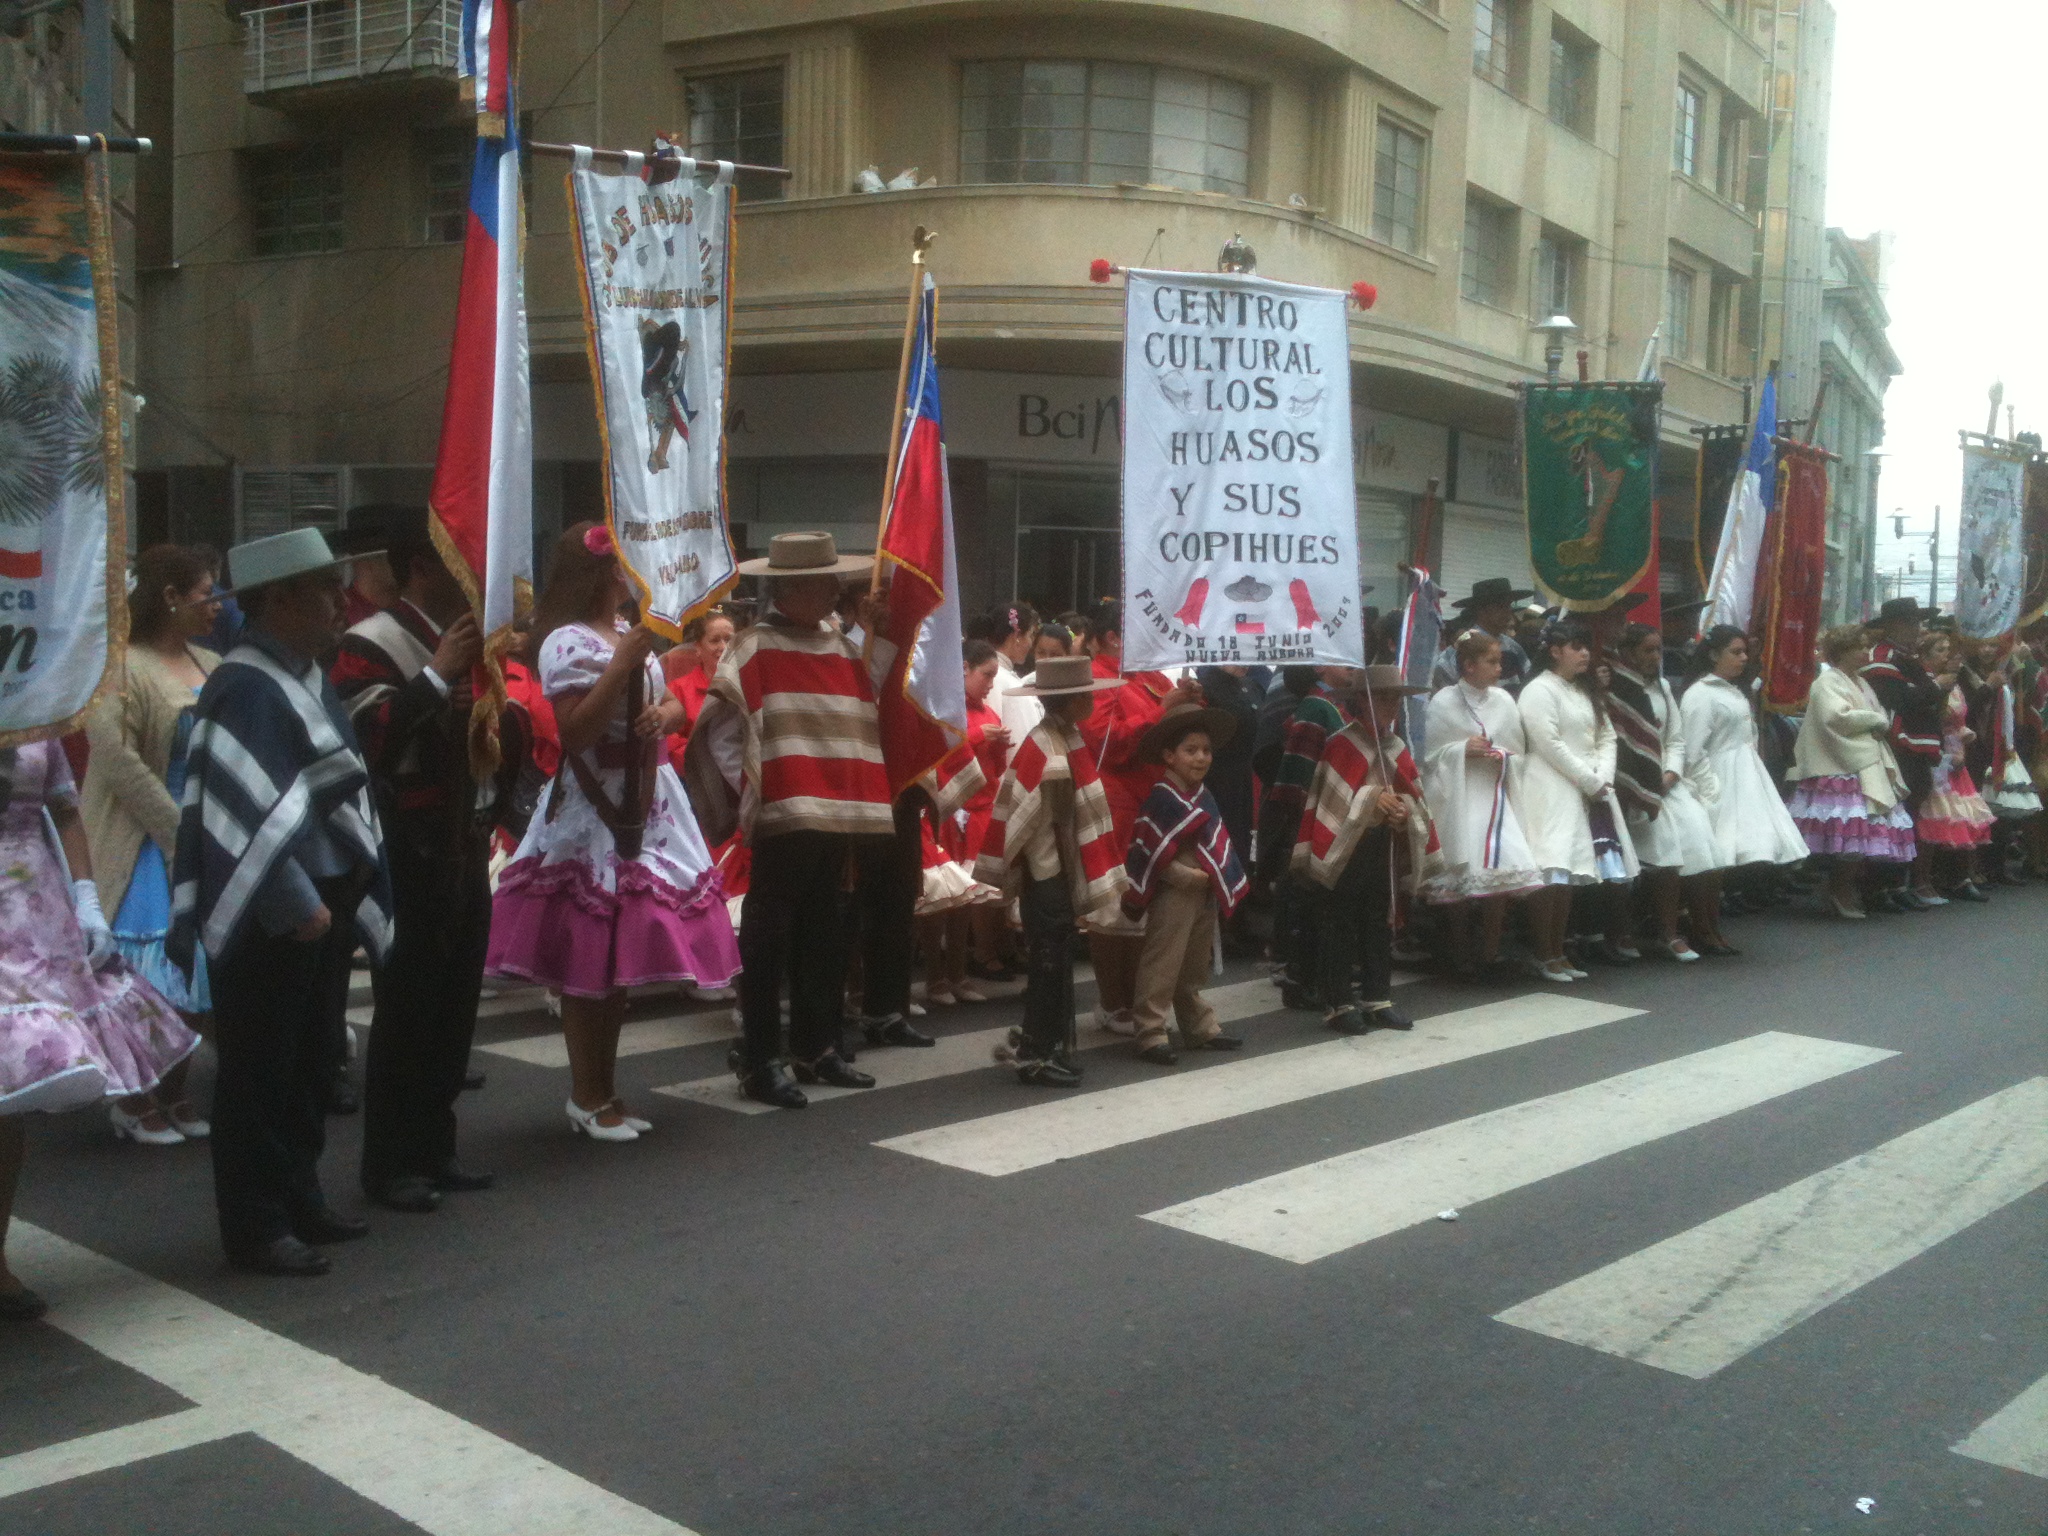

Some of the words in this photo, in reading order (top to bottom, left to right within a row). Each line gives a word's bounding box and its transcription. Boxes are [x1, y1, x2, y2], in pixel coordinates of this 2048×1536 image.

[1153, 285, 1298, 331] CENTRO
[1145, 331, 1320, 376] CULTURAL
[1205, 375, 1279, 411] LOS
[1171, 428, 1320, 465] HUASOS
[1170, 482, 1195, 516] Y
[1223, 482, 1301, 517] SUS
[1159, 530, 1339, 565] COPIHUES
[0, 589, 37, 611] ca
[1135, 588, 1206, 649] FUNDADO
[1255, 633, 1312, 649] JUNIO
[1185, 649, 1241, 663] NUEVA
